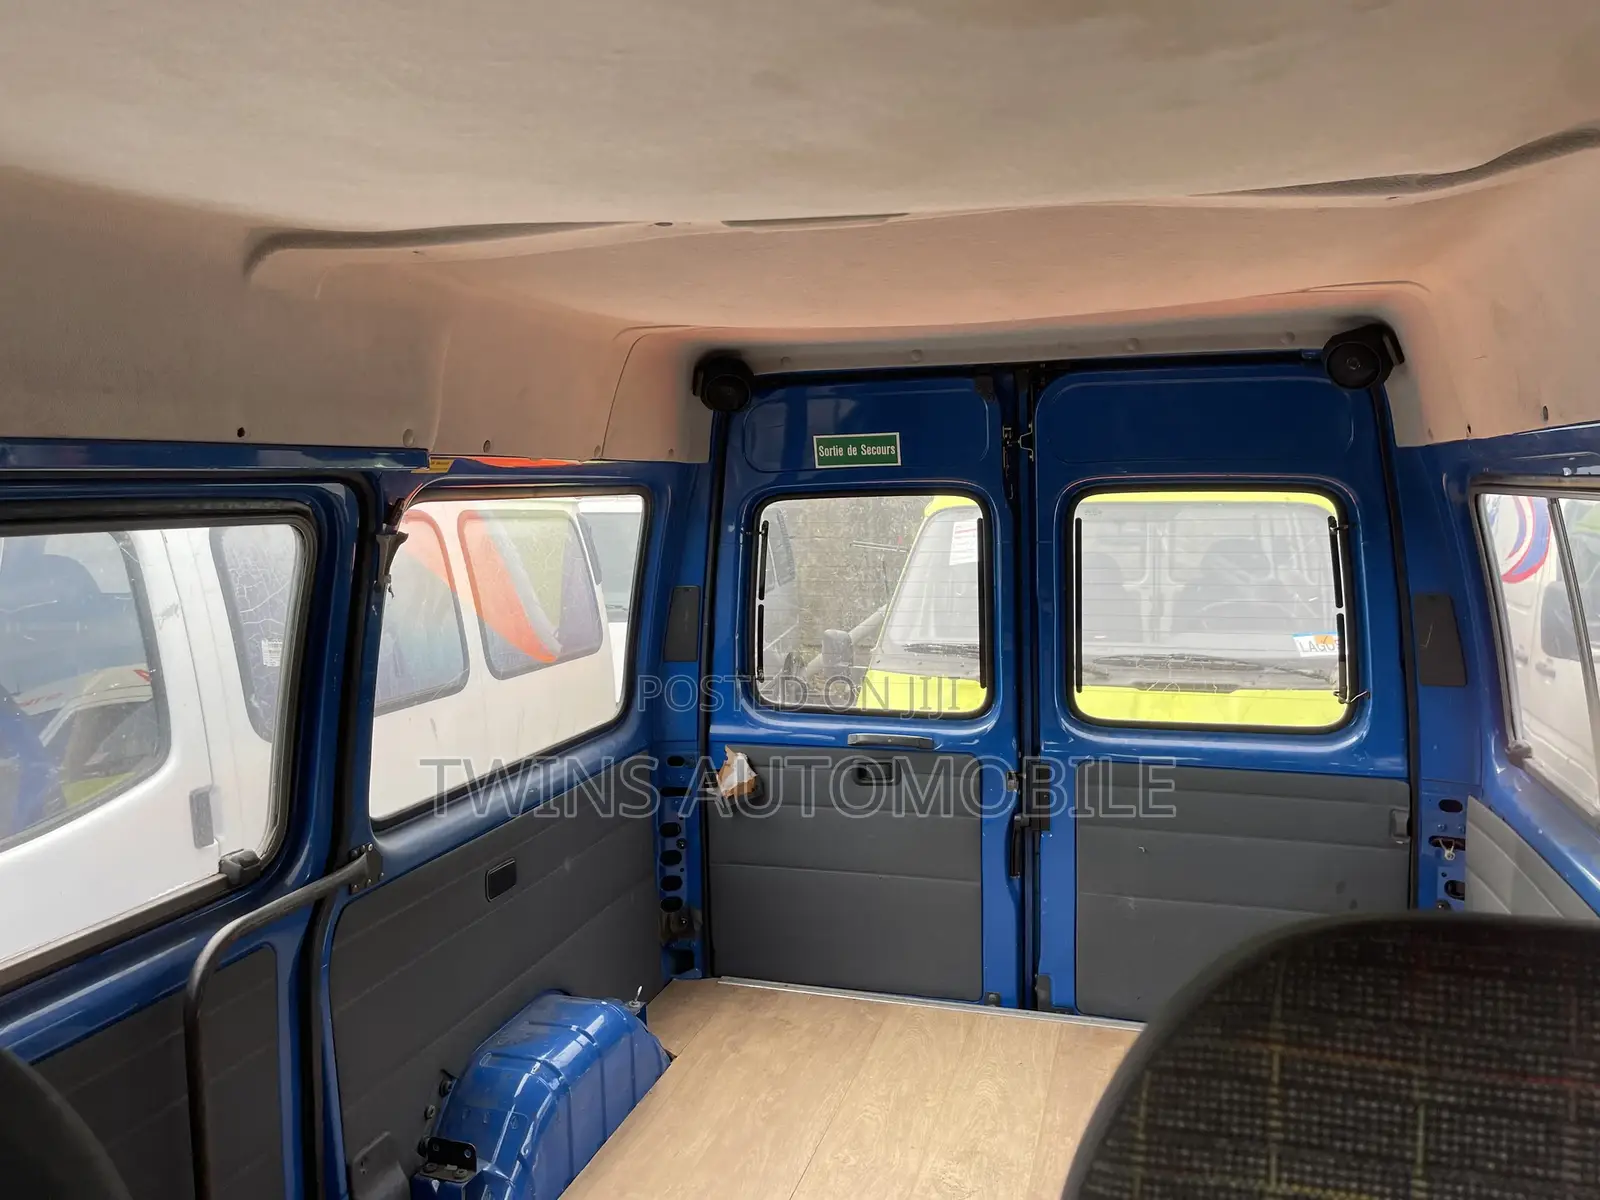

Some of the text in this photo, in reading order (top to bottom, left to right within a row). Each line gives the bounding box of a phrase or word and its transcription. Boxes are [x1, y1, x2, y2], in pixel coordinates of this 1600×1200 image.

[818, 443, 896, 457] Sortie de Secours
